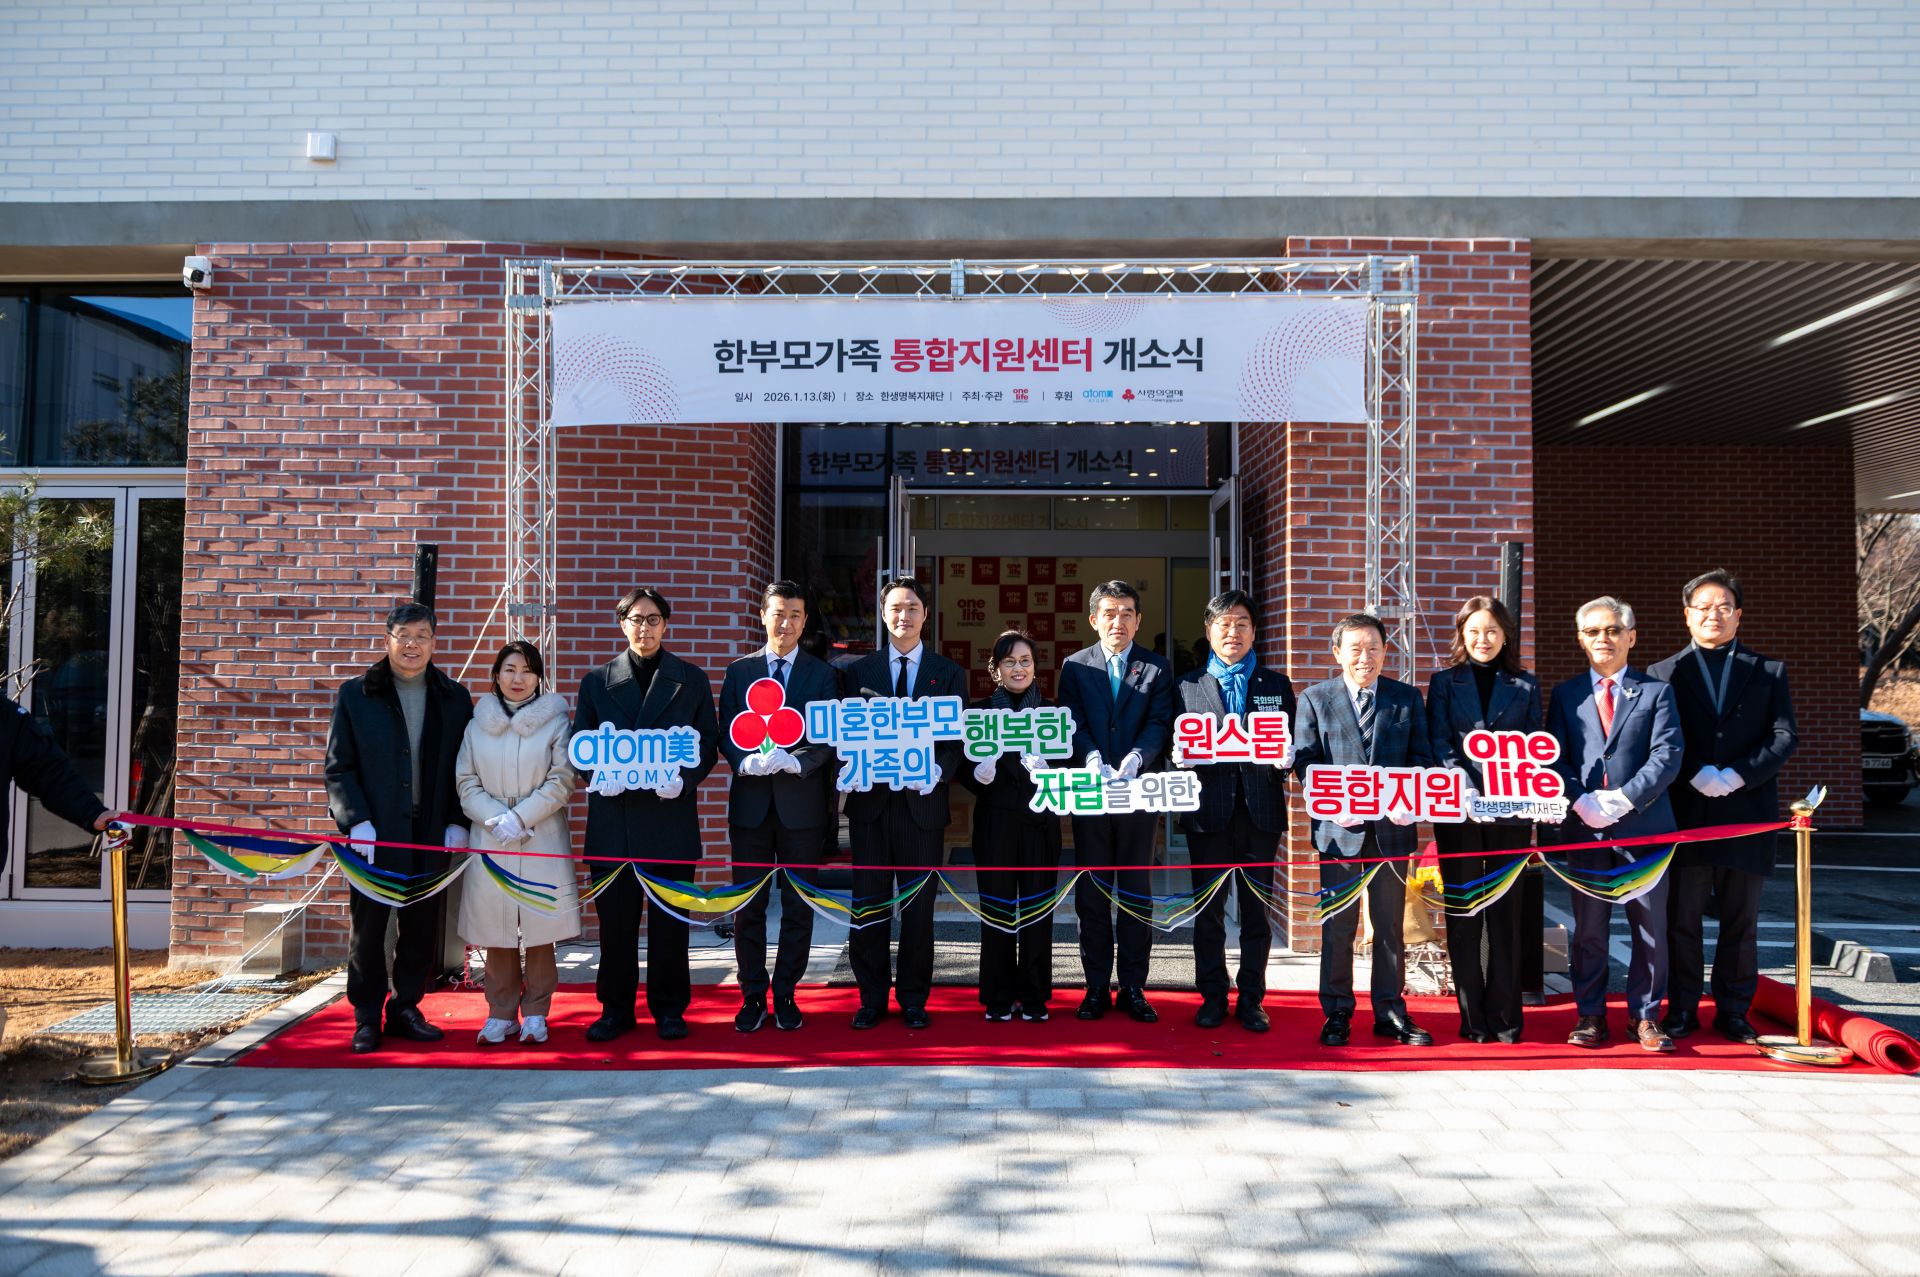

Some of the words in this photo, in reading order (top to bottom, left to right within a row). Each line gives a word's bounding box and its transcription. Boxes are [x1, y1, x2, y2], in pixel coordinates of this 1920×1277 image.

[713, 339, 882, 373] 한부모가족
[890, 338, 1092, 373] 통합지원센터
[1103, 337, 1203, 372] 개소식
[734, 392, 753, 402] 일시
[763, 391, 836, 402] 2026.1.13.(화)
[855, 391, 874, 401] 장소
[880, 391, 944, 402] 한생명복지재단
[1054, 391, 1073, 401] 후원
[957, 599, 985, 609] one
[962, 608, 985, 621] life
[1253, 695, 1283, 705] 국회의원
[810, 699, 962, 742] 미혼한부모
[965, 711, 1071, 756] 행복한
[1178, 716, 1287, 760] 원스톱
[573, 726, 695, 765] atom美
[1468, 733, 1556, 761] one
[595, 768, 675, 785] ATOMY
[841, 746, 932, 786] 가족의
[1487, 761, 1560, 798] life
[1035, 772, 1131, 811] 자립을
[1140, 773, 1197, 807] 위한
[1308, 767, 1460, 819] 통합지원
[1473, 800, 1563, 816] 한생명복지재단
